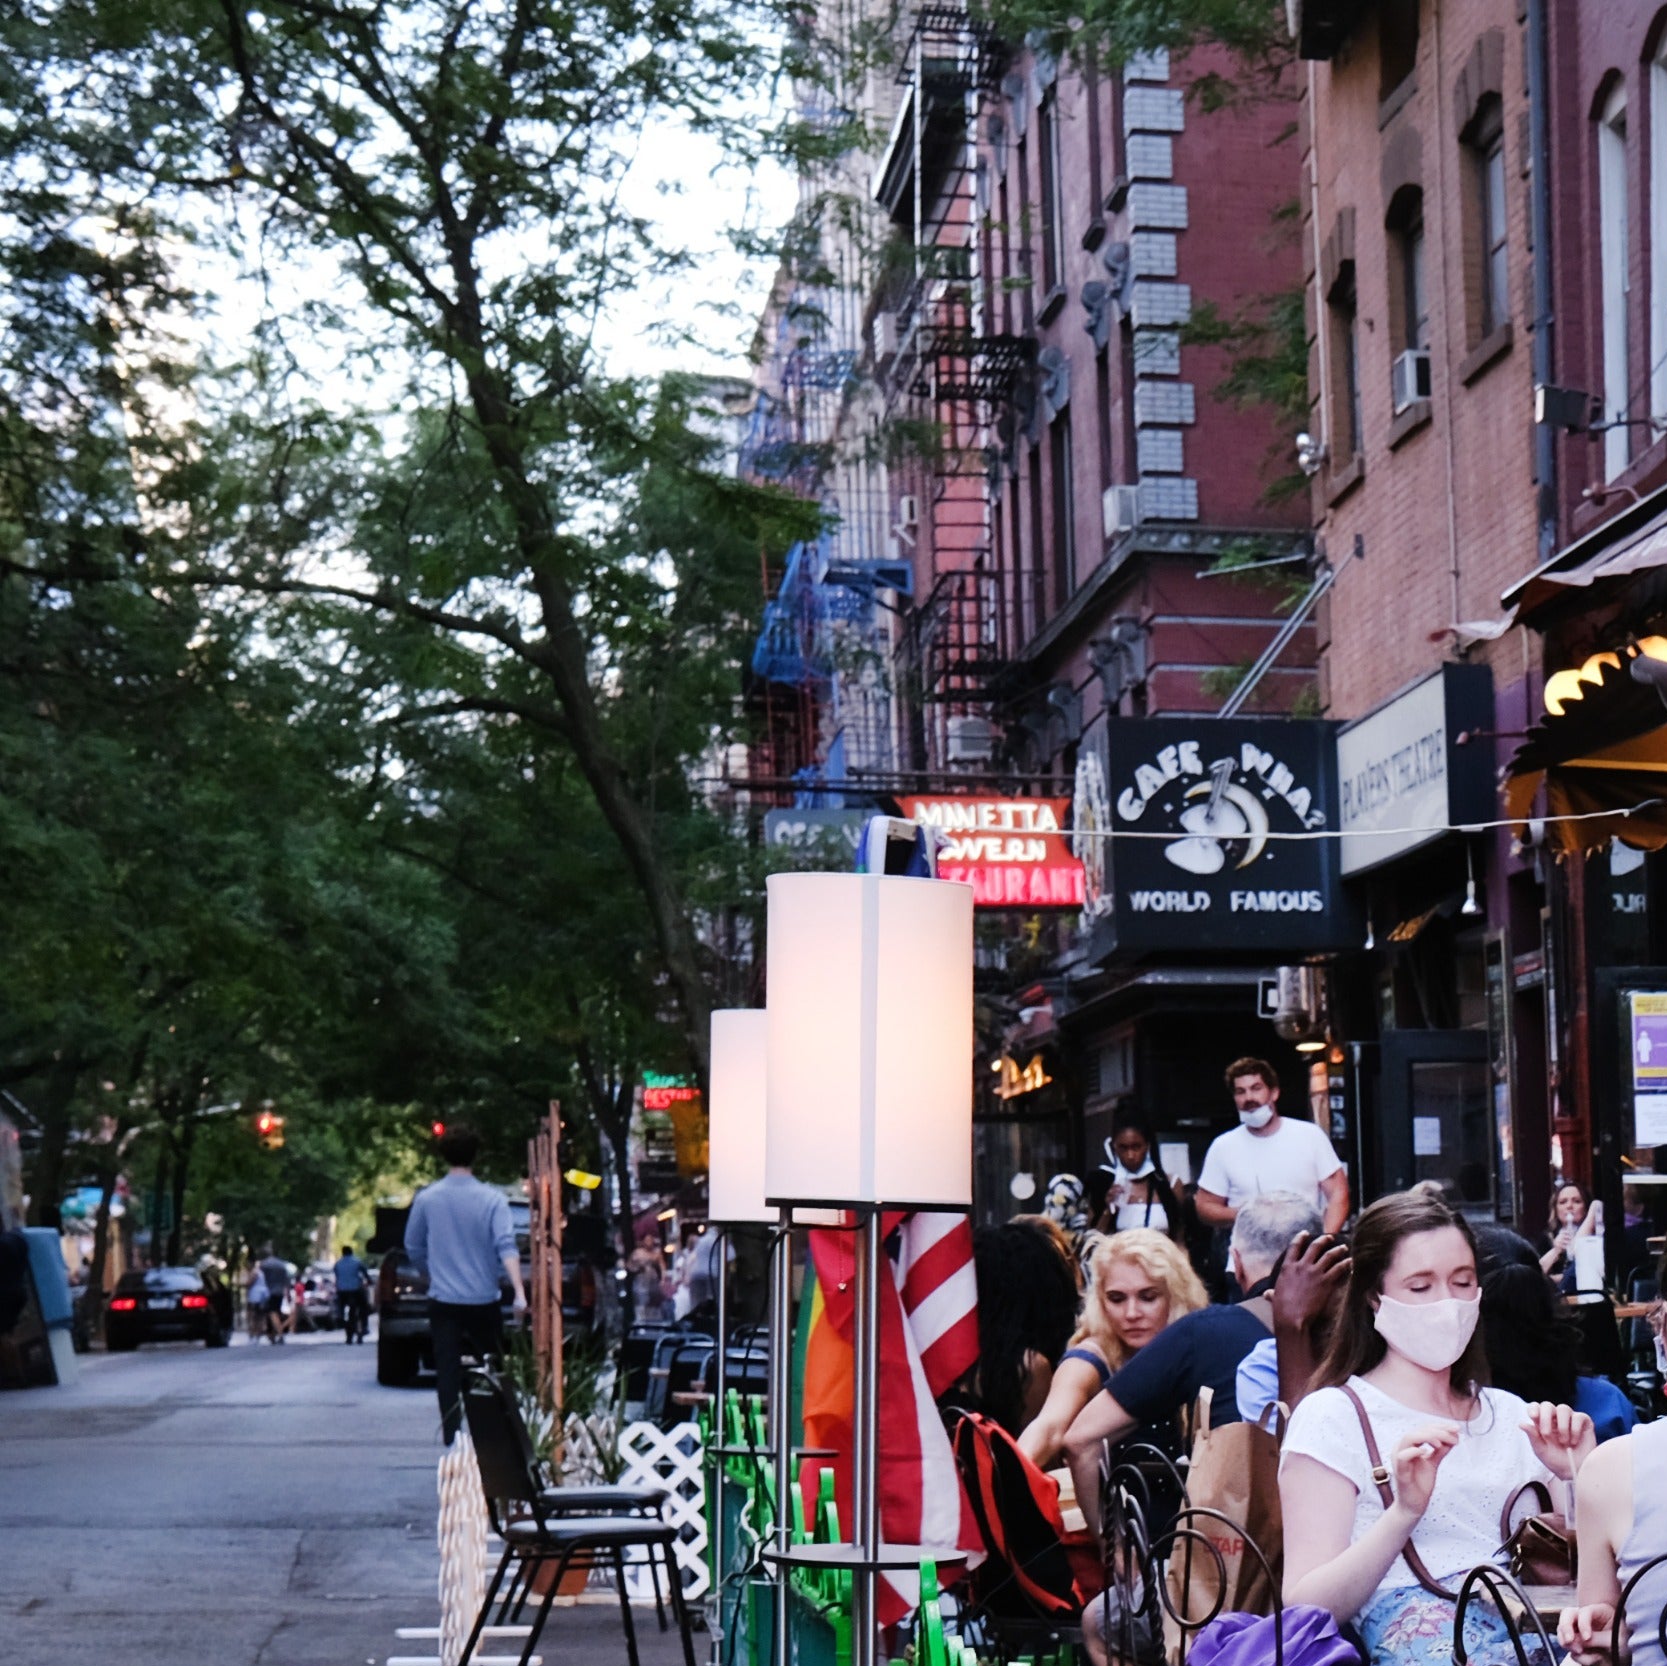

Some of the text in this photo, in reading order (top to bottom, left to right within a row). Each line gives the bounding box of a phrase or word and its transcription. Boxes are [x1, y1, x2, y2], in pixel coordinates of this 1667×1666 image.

[1117, 740, 1327, 830] CAFE WHA?
[914, 801, 1060, 832] MINETTA
[1130, 889, 1324, 913] WORLD FAMOUS
